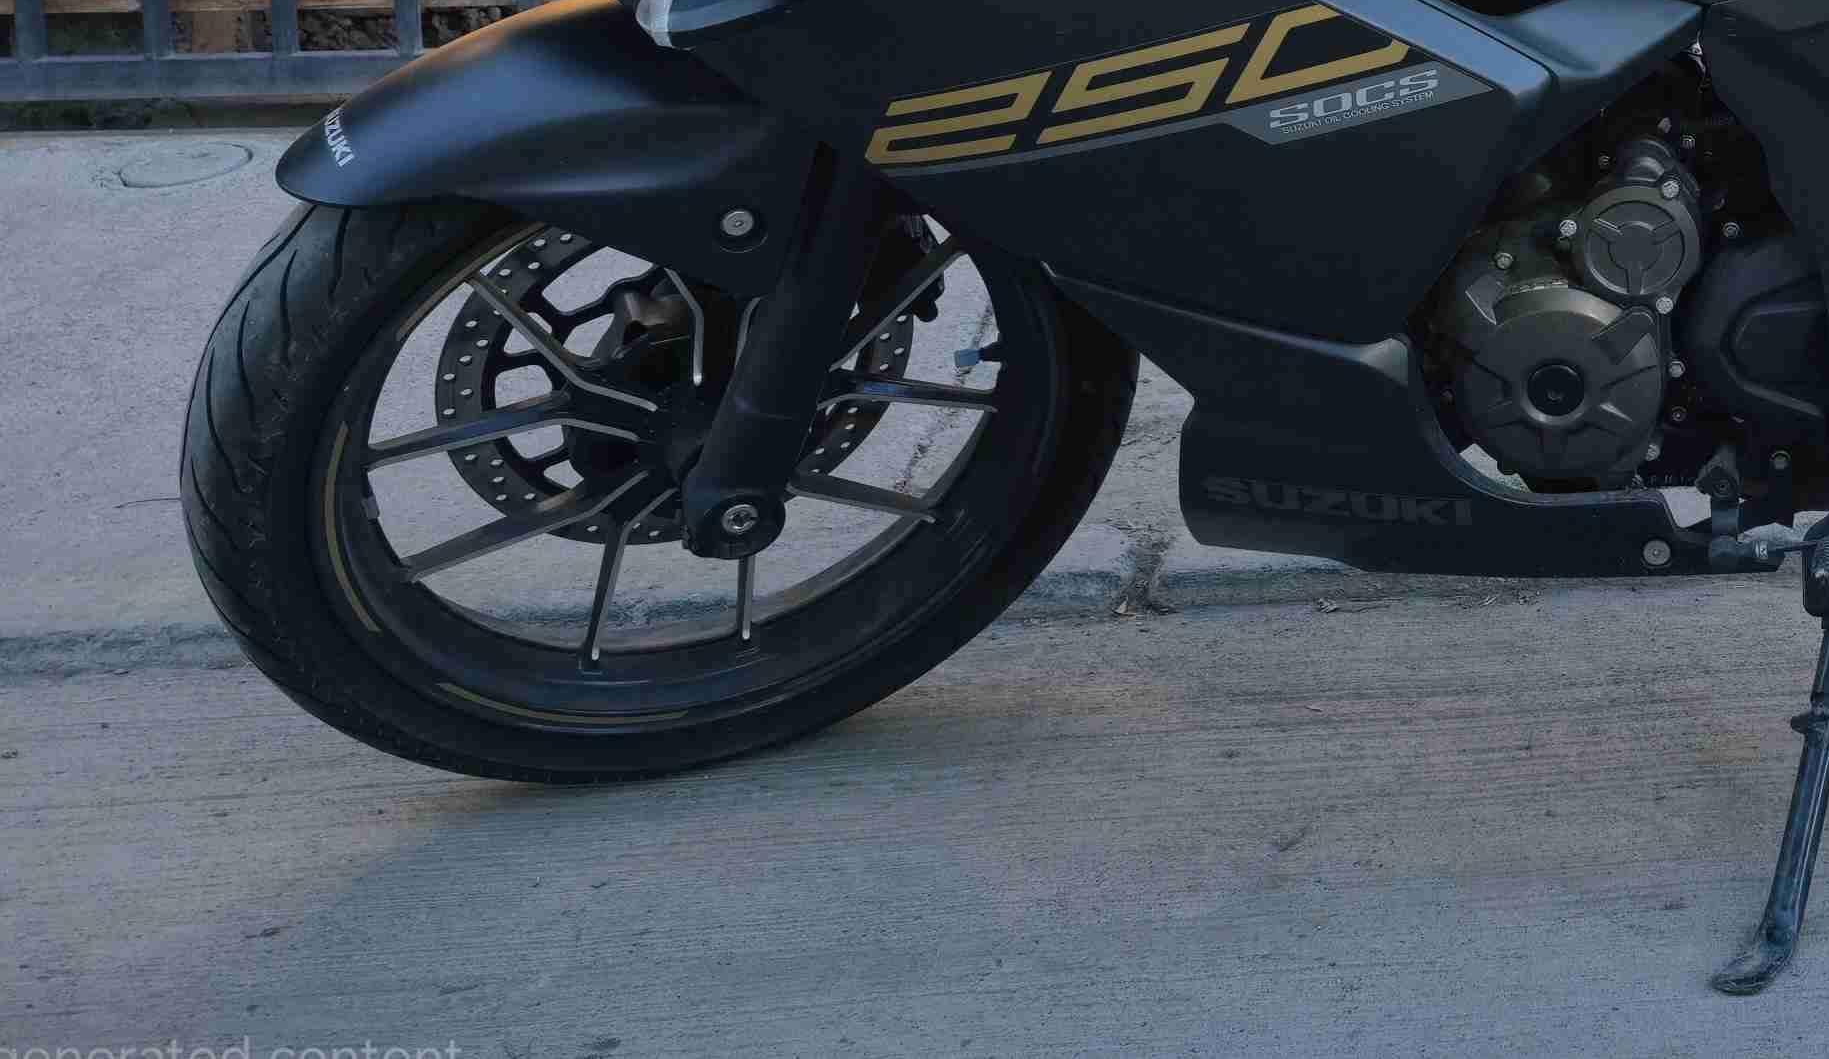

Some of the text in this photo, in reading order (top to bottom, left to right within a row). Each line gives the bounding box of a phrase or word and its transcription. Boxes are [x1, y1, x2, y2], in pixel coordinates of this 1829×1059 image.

[864, 3, 1411, 165] 250
[1269, 69, 1440, 129] SOCS
[1281, 118, 1323, 135] SUZUKI
[1324, 114, 1341, 126] OIL
[1390, 90, 1435, 109] SYSTEM
[325, 108, 355, 167] UZUKI
[1200, 477, 1473, 526] SUZUKI
